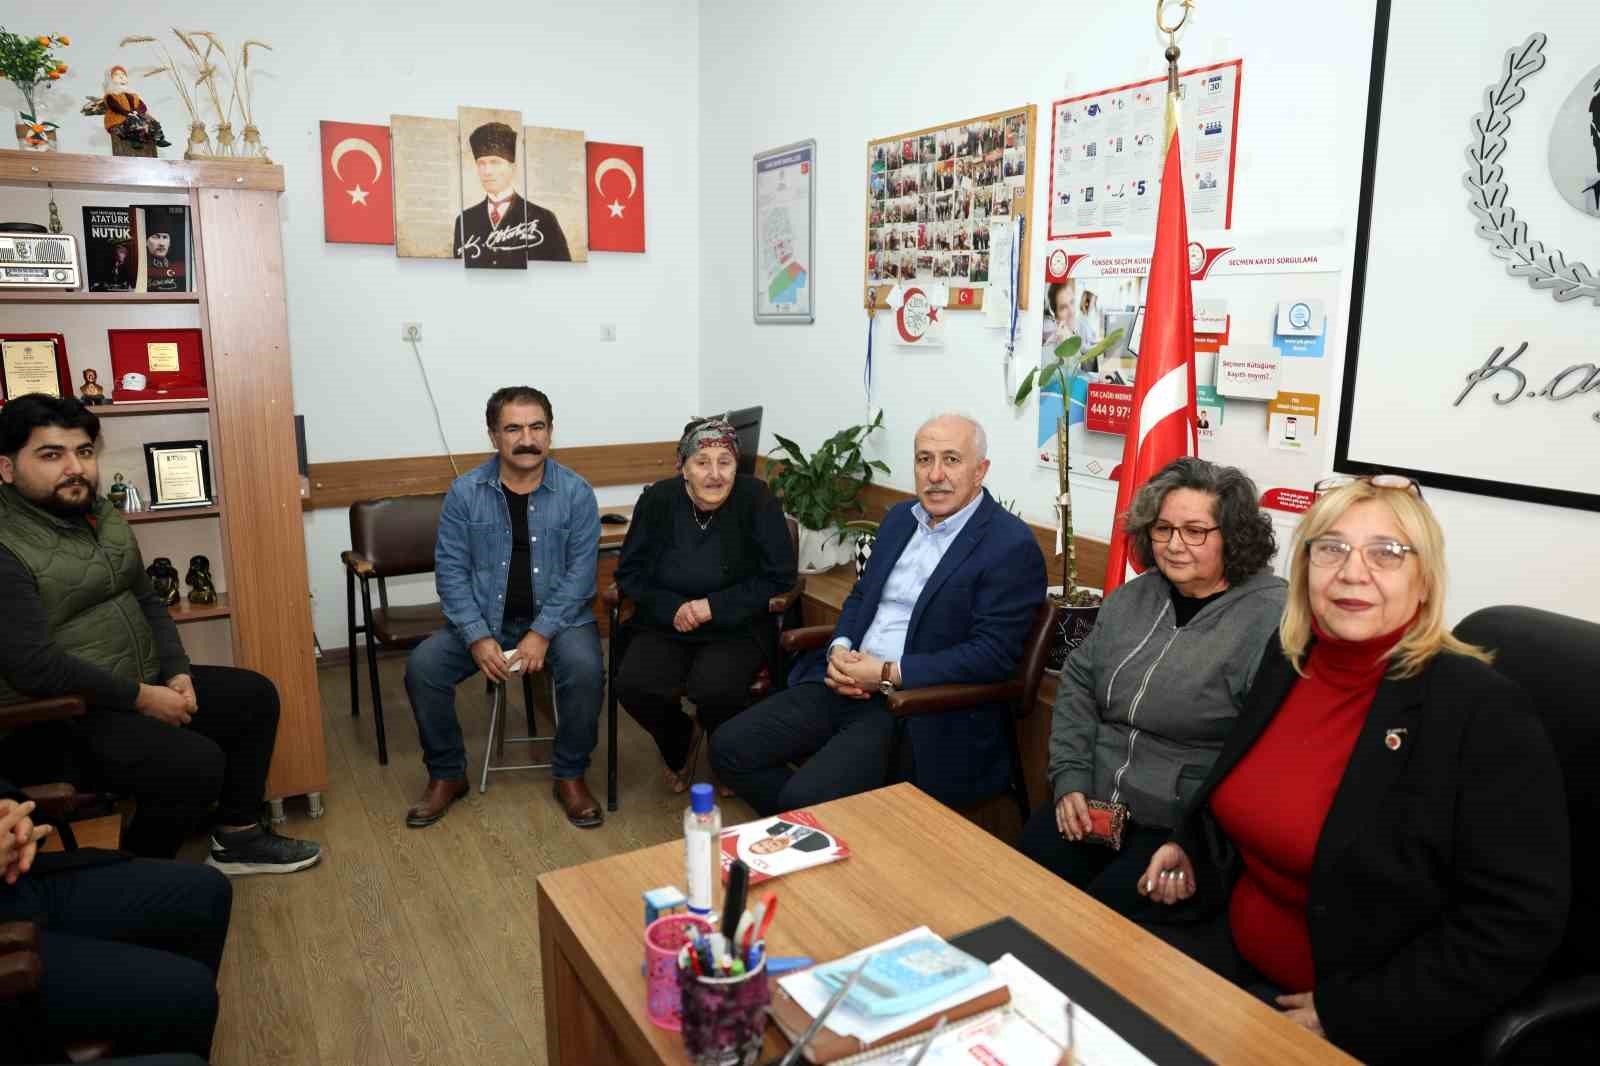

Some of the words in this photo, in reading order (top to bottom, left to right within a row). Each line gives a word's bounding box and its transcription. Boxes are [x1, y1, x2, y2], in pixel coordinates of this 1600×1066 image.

[1209, 82, 1221, 92] 30
[1137, 180, 1146, 196] 5
[91, 212, 130, 224] ATATÜRK
[91, 227, 132, 239] NUTUK
[1276, 255, 1318, 265] SORGULAMA
[1090, 403, 1107, 417] 444
[1109, 404, 1115, 417] 9
